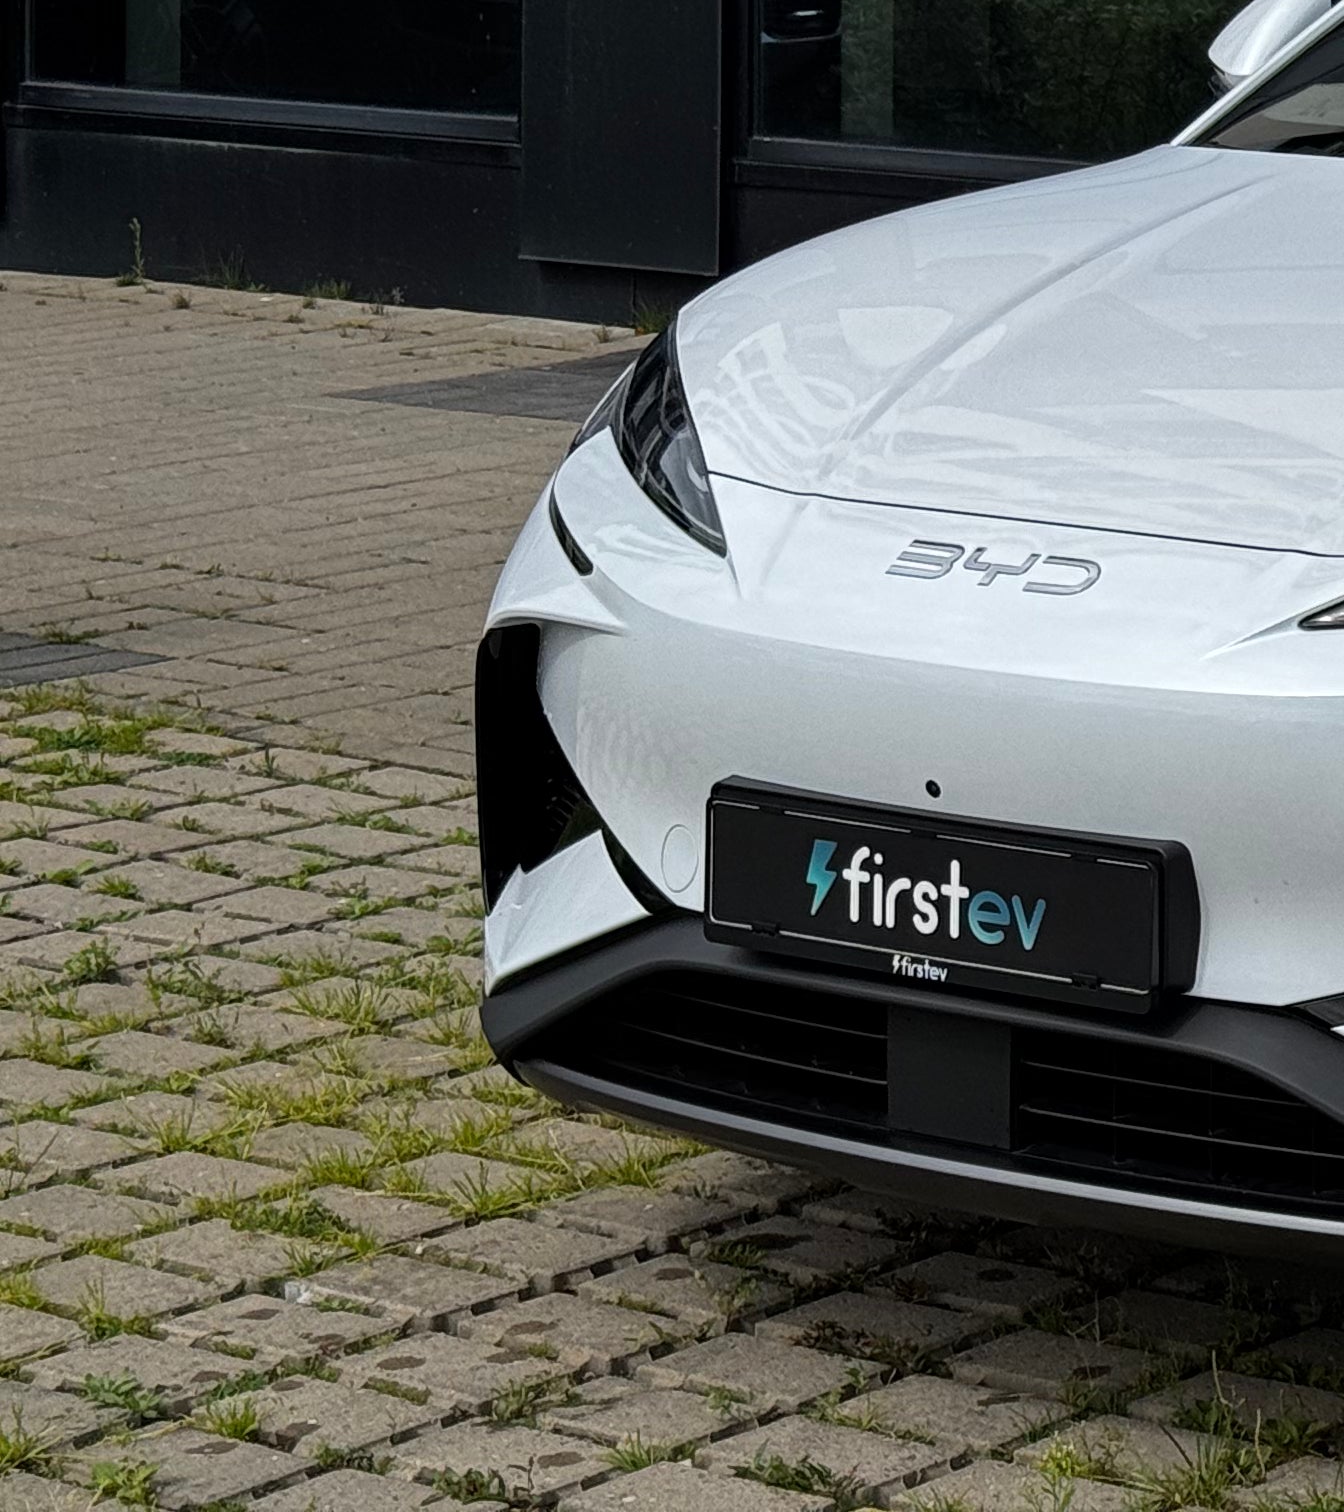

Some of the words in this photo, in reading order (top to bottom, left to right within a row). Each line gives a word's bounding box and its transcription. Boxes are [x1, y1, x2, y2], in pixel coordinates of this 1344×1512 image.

[885, 539, 1101, 596] BYD
[842, 845, 1047, 951] firstev
[901, 957, 948, 983] firstev
